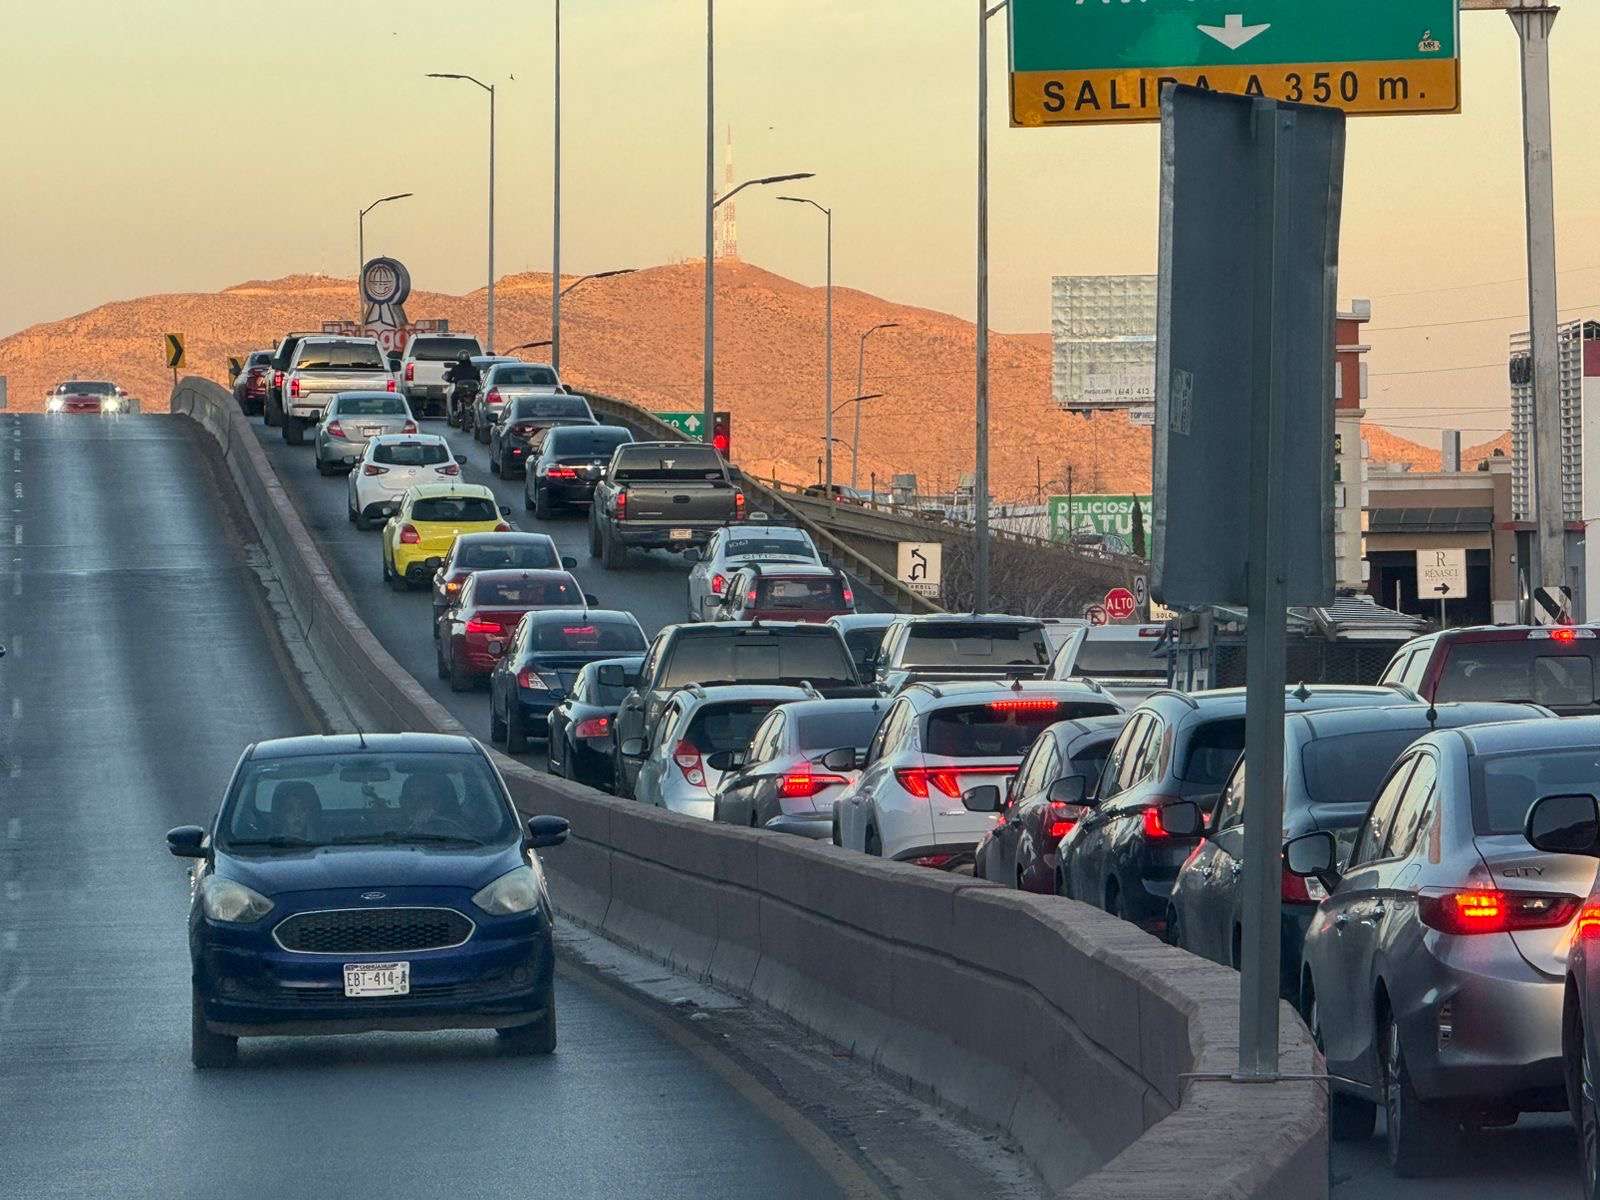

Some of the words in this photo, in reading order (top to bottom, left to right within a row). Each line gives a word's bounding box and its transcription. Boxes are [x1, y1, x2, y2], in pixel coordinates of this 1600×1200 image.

[1285, 71, 1358, 103] 350
[1379, 76, 1426, 100] m.
[1436, 551, 1446, 567] R
[1106, 597, 1133, 610] ALTO
[1502, 866, 1545, 878] CITY
